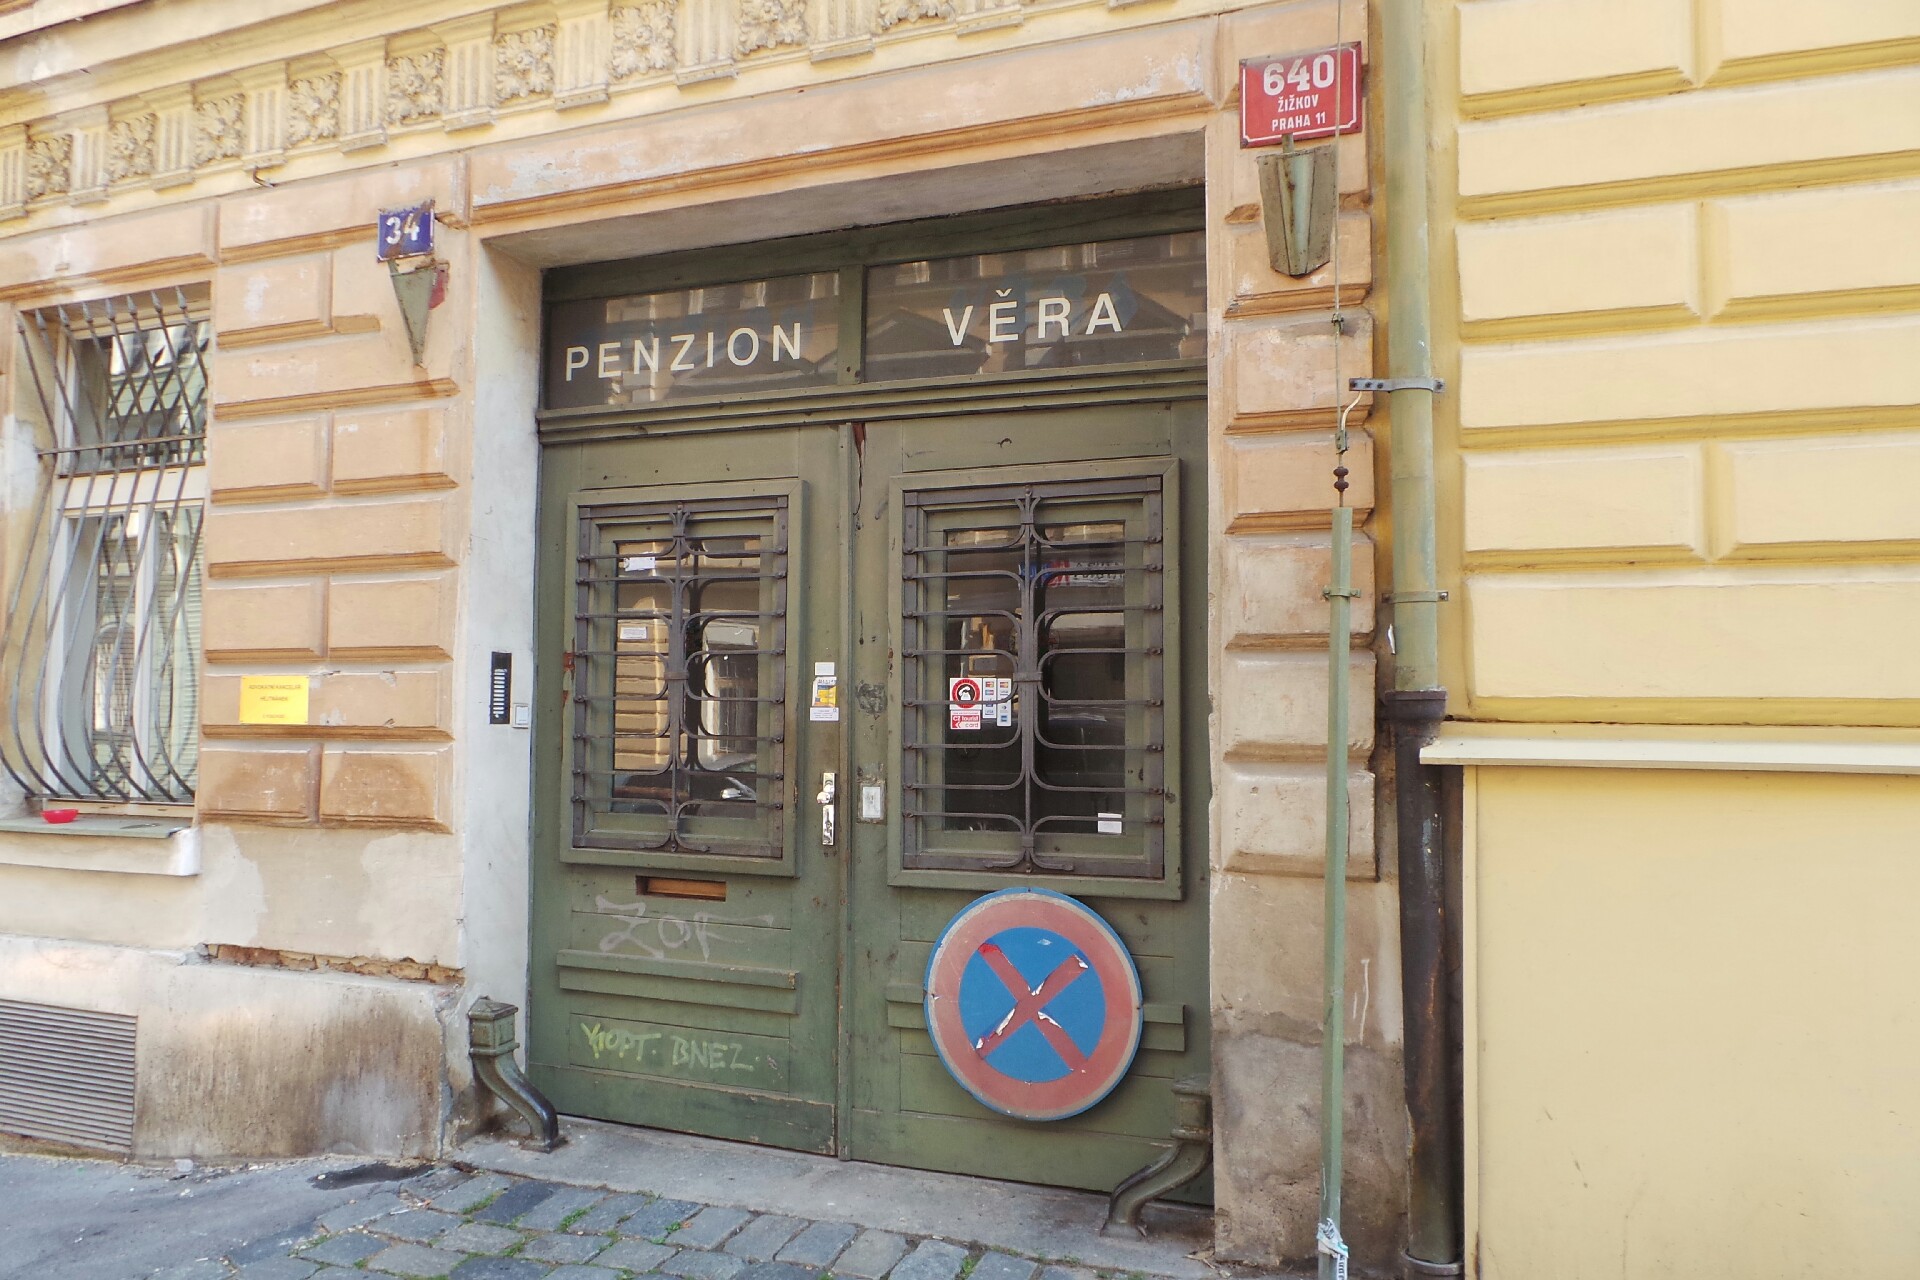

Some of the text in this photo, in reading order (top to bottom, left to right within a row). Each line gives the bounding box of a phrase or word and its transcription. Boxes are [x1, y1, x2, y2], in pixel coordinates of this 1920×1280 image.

[1263, 54, 1335, 96] 640
[1277, 94, 1319, 113] ŽIŽKOV
[1272, 111, 1326, 132] PRAHA 11
[385, 212, 420, 245] 34
[566, 288, 1122, 382] PENZION VĚRA
